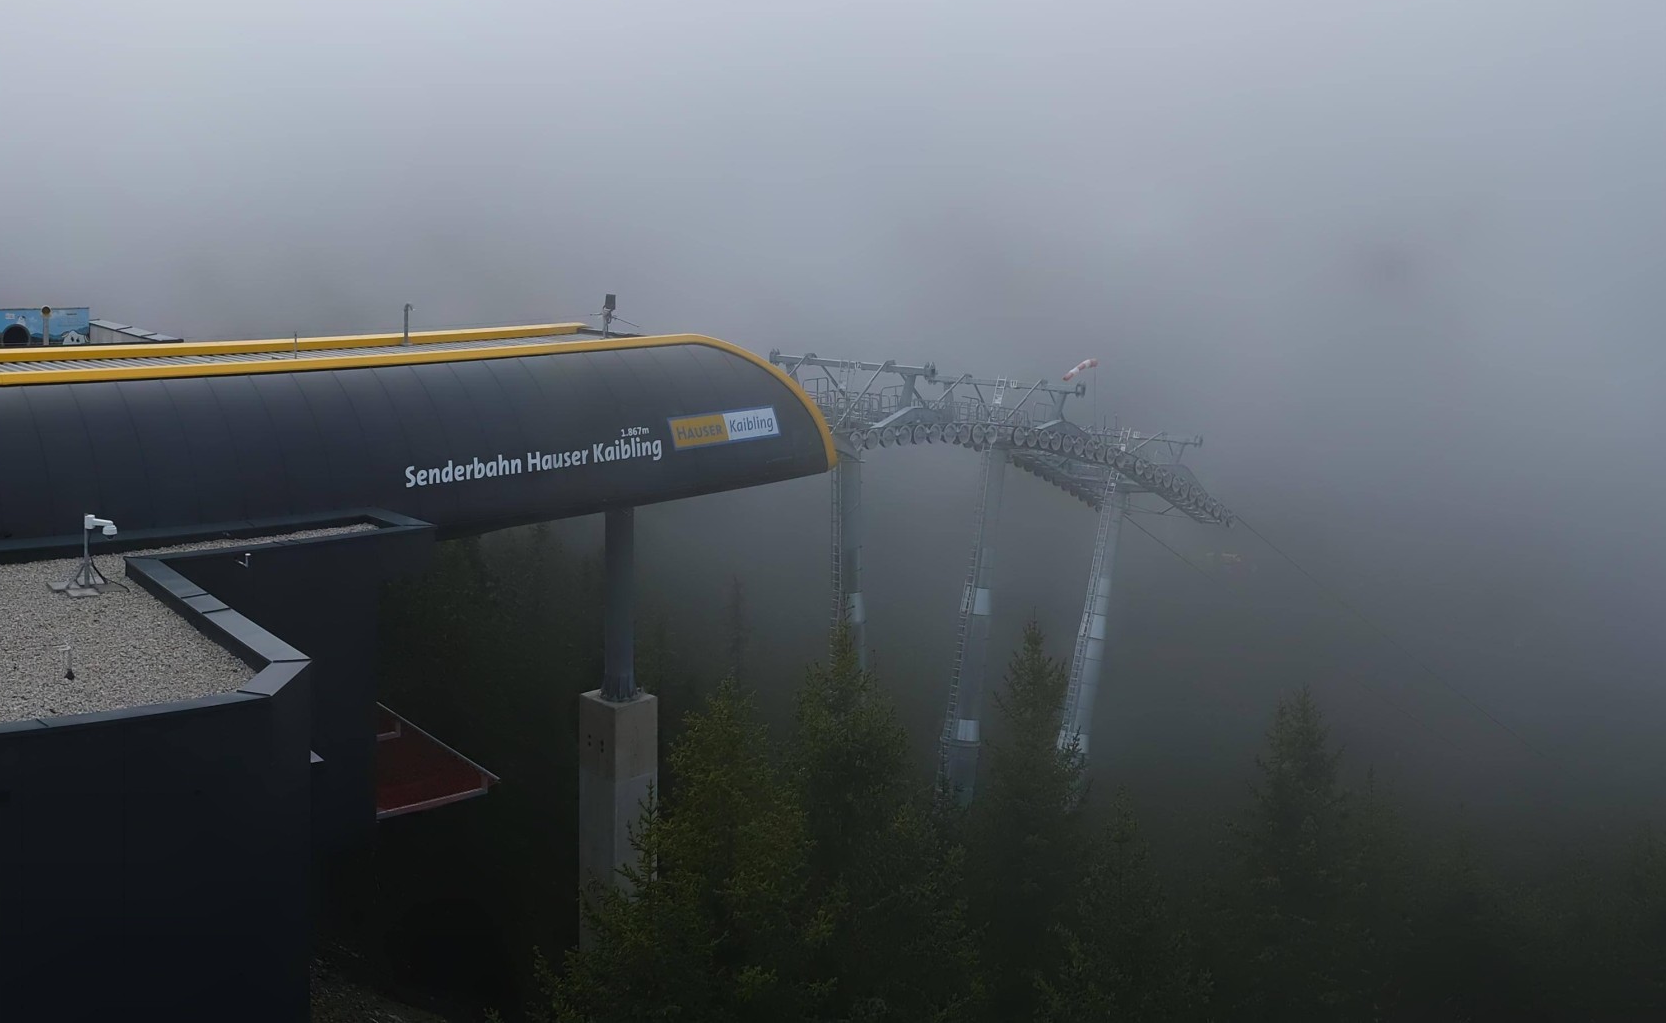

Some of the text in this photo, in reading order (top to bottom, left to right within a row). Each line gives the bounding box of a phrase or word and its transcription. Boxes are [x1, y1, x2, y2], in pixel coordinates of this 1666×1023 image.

[620, 426, 650, 437] 1.867m
[676, 415, 774, 440] HAUSER Kaibling
[405, 439, 662, 488] Senderbahn Hauser Kaibling
